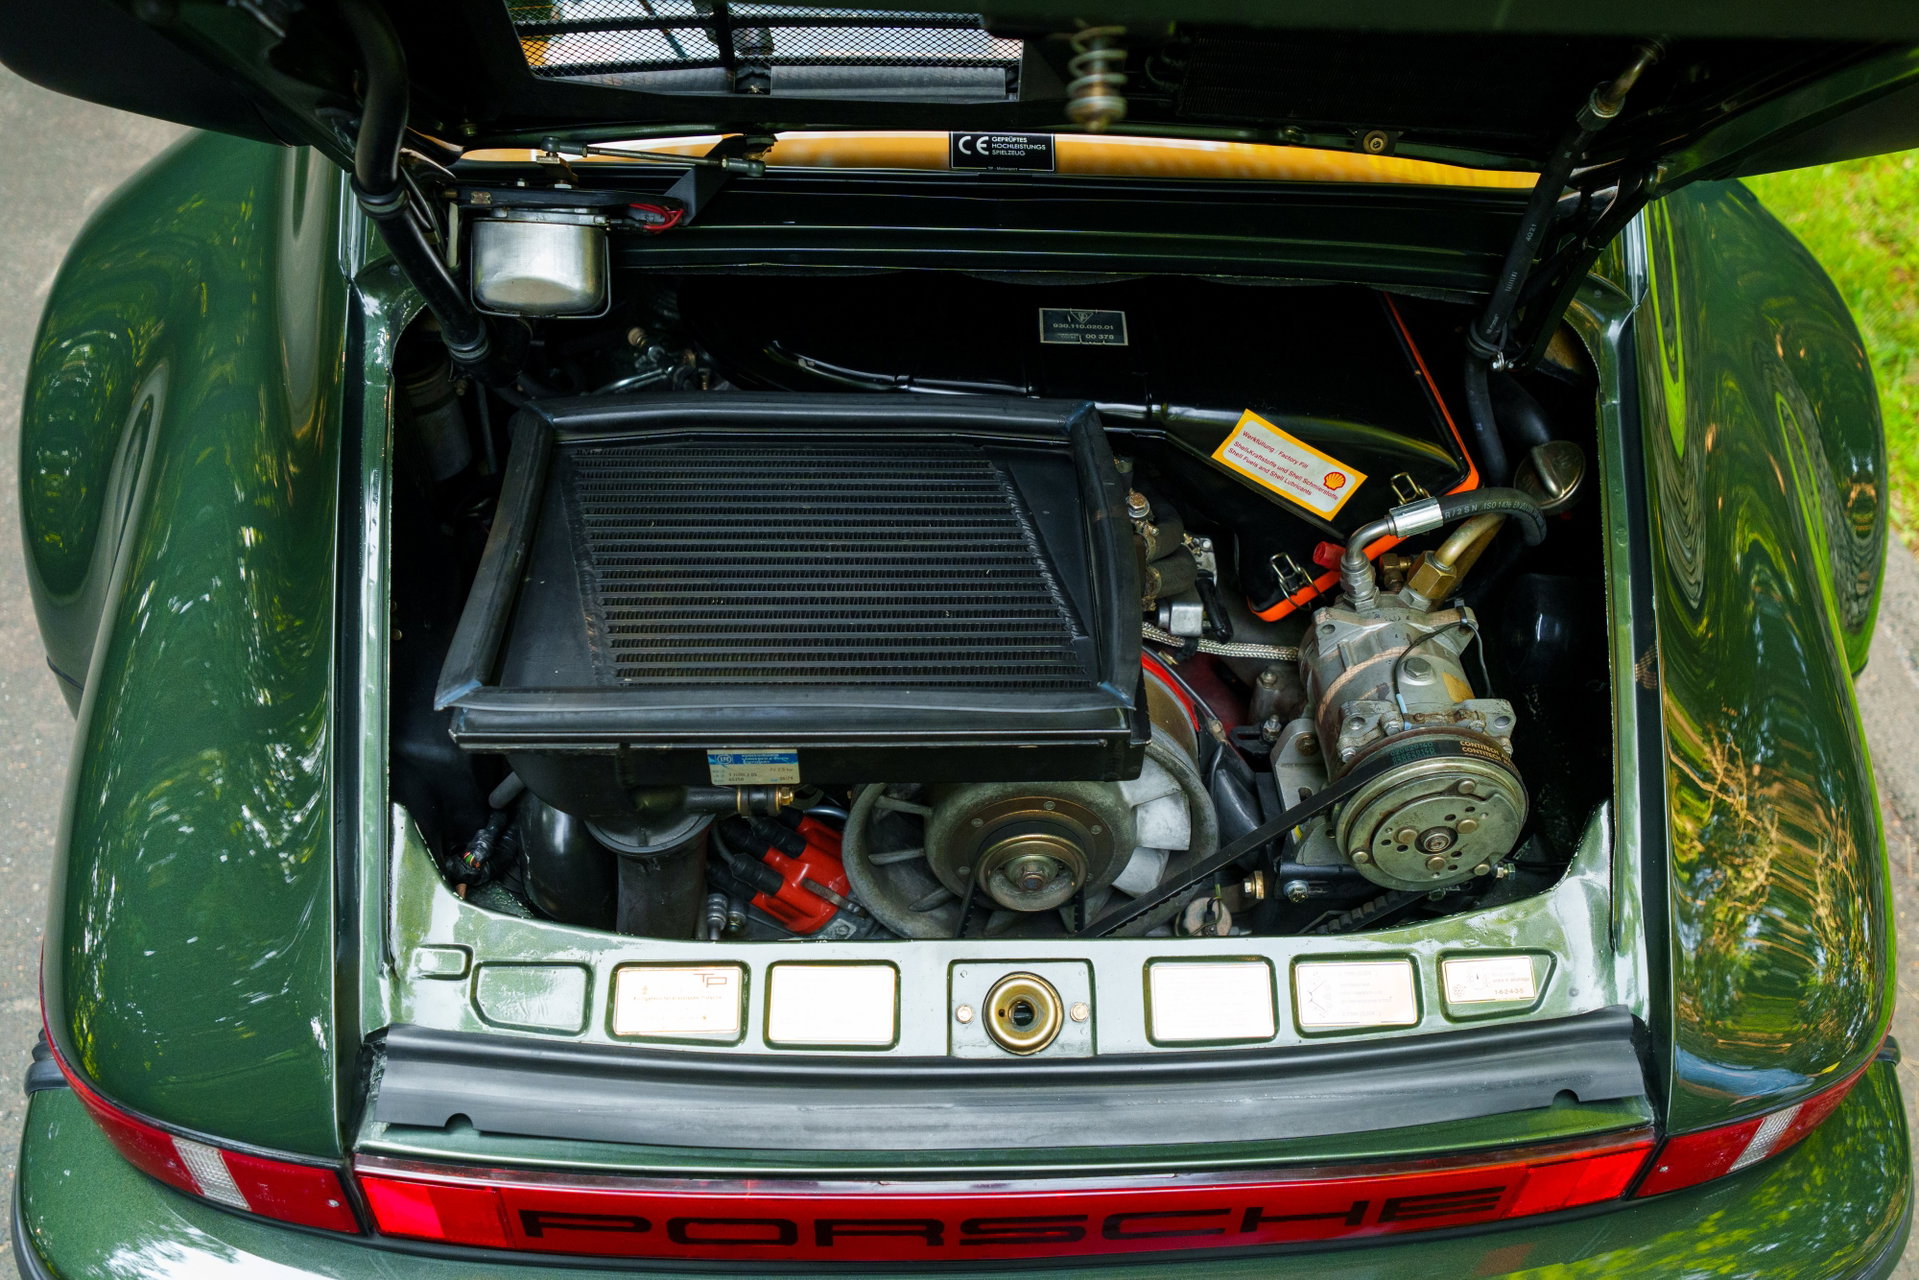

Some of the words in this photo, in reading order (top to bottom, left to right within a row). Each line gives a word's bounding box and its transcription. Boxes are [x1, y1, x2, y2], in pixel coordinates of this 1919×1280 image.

[958, 135, 989, 155] CE
[1242, 430, 1275, 453] Werkfüllung
[1277, 450, 1302, 466] Factory
[1298, 460, 1309, 470] Fill
[1228, 447, 1244, 459] Shell
[1243, 455, 1258, 468] Fuels
[1258, 464, 1270, 474] and
[1269, 470, 1285, 482] Shell
[1284, 478, 1312, 496] Lubricants
[1277, 465, 1289, 475] und
[1289, 470, 1304, 481] Shell
[1302, 477, 1339, 501] Schmierstoffe
[1459, 740, 1500, 756] CONTITECH
[1461, 747, 1502, 761] CONTITECH
[521, 1190, 1503, 1247] PORSCHE
